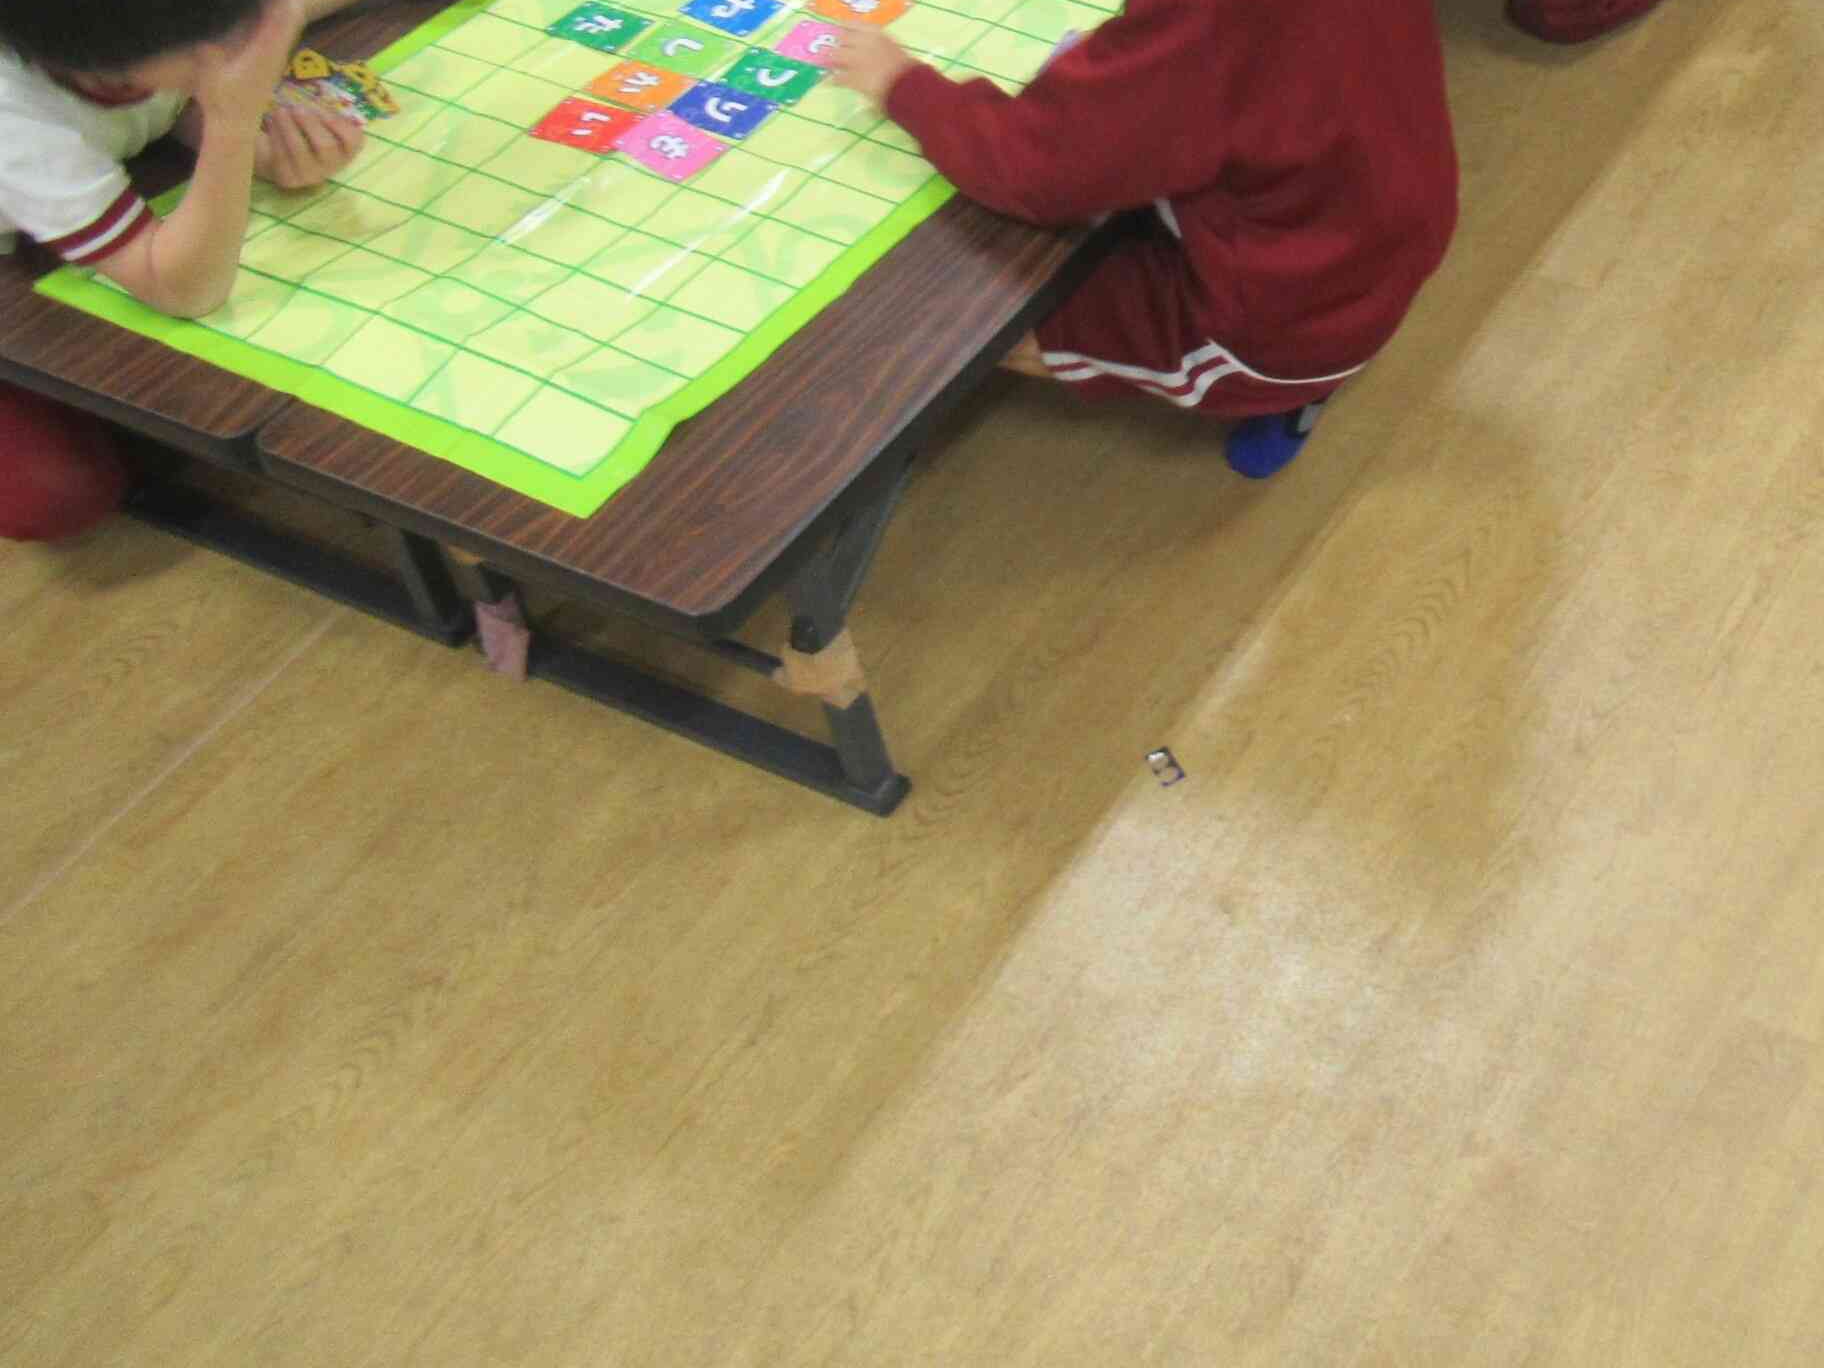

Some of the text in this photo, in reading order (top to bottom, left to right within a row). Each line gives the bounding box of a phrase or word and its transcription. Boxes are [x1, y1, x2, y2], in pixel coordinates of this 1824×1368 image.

[662, 38, 705, 57] し
[617, 71, 661, 93] か
[756, 68, 800, 88] つ
[704, 96, 749, 124] り
[570, 111, 612, 137] い
[650, 134, 690, 161] も
